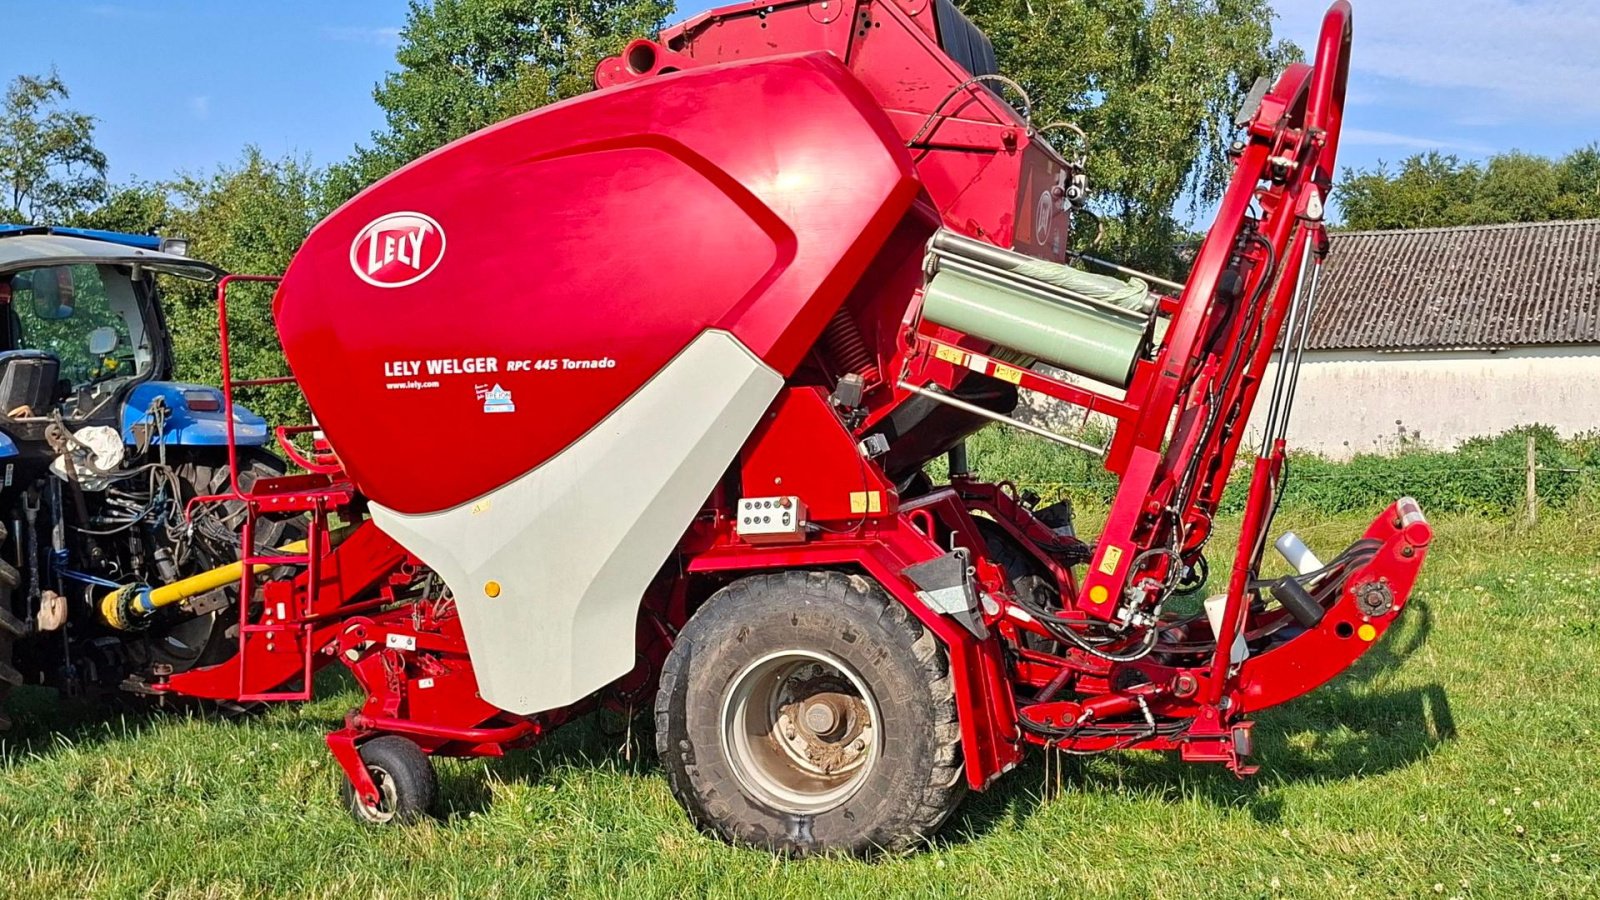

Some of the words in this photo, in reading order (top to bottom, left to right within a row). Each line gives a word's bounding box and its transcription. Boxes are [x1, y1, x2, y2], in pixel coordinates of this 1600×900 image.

[368, 225, 426, 276] LELY
[384, 360, 421, 377] LELY
[426, 357, 498, 375] WELGER
[506, 360, 532, 372] RPC
[534, 359, 558, 371] 445
[562, 357, 616, 370] Tornado
[386, 380, 440, 391] www.lely.com
